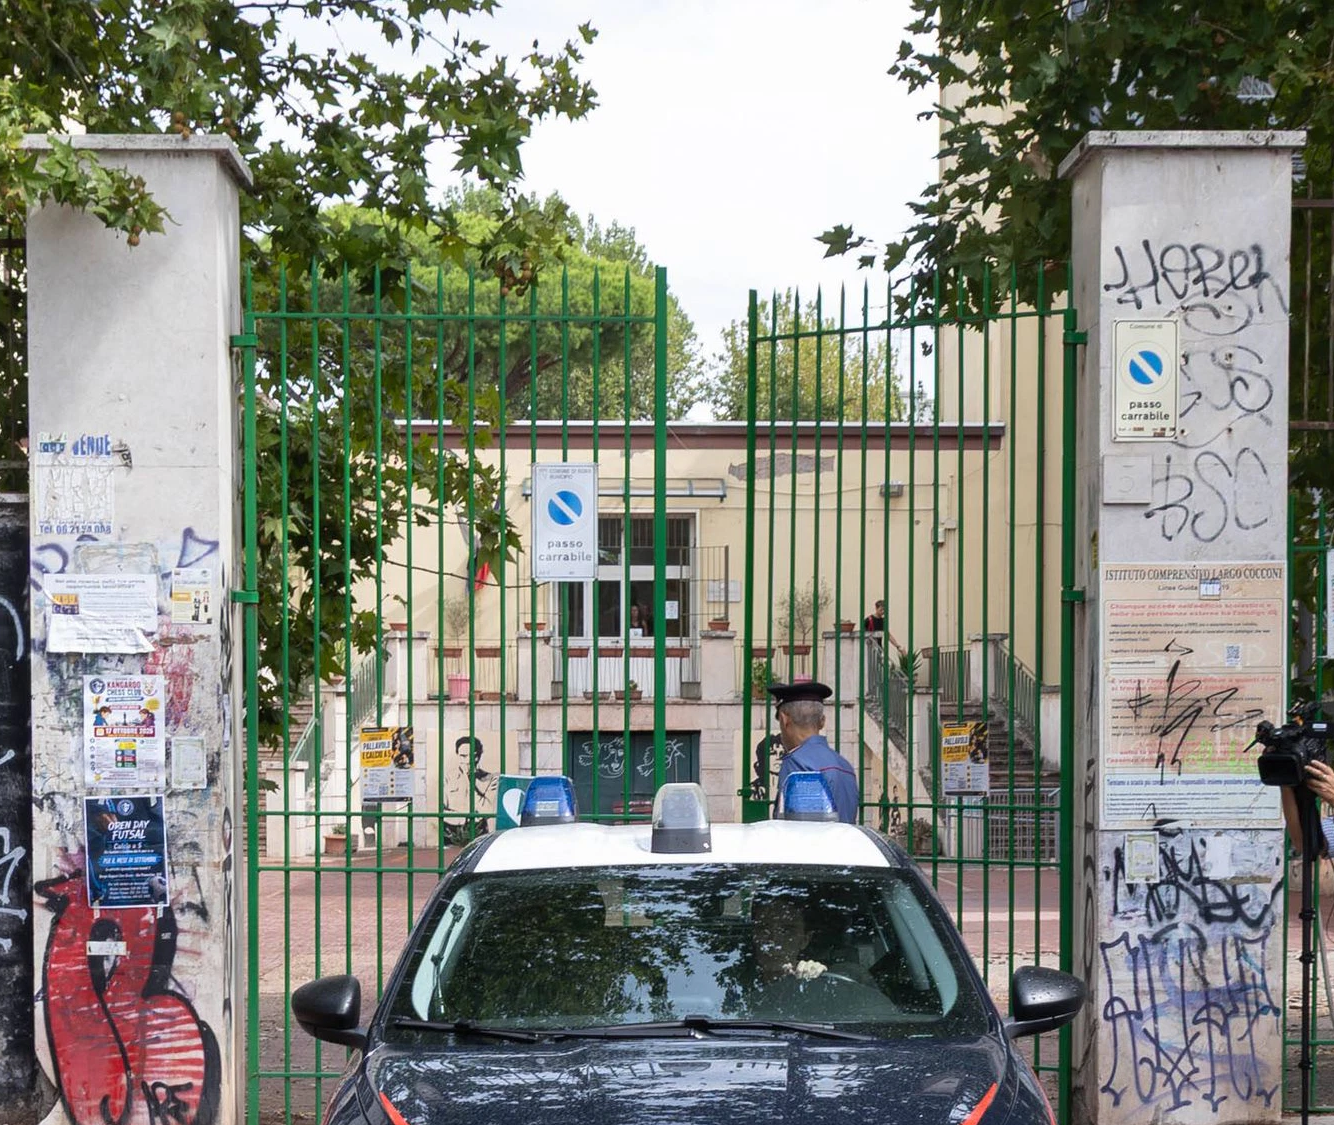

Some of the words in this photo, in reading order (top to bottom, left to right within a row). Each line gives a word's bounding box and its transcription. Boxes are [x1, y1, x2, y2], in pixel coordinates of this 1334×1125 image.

[1129, 400, 1162, 410] passo
[1121, 411, 1170, 421] carrabile
[547, 540, 583, 549] passo
[538, 552, 592, 562] carrabile
[1105, 569, 1146, 581] ISTITUTO
[1147, 568, 1210, 581] COMPRENSIVO
[1212, 568, 1242, 580] LARGO
[1243, 567, 1283, 580] COCCONI
[107, 681, 141, 689] KANGAROO
[108, 821, 132, 831] OPEN
[133, 820, 150, 830] DAY
[112, 830, 146, 841] FUTSAL
